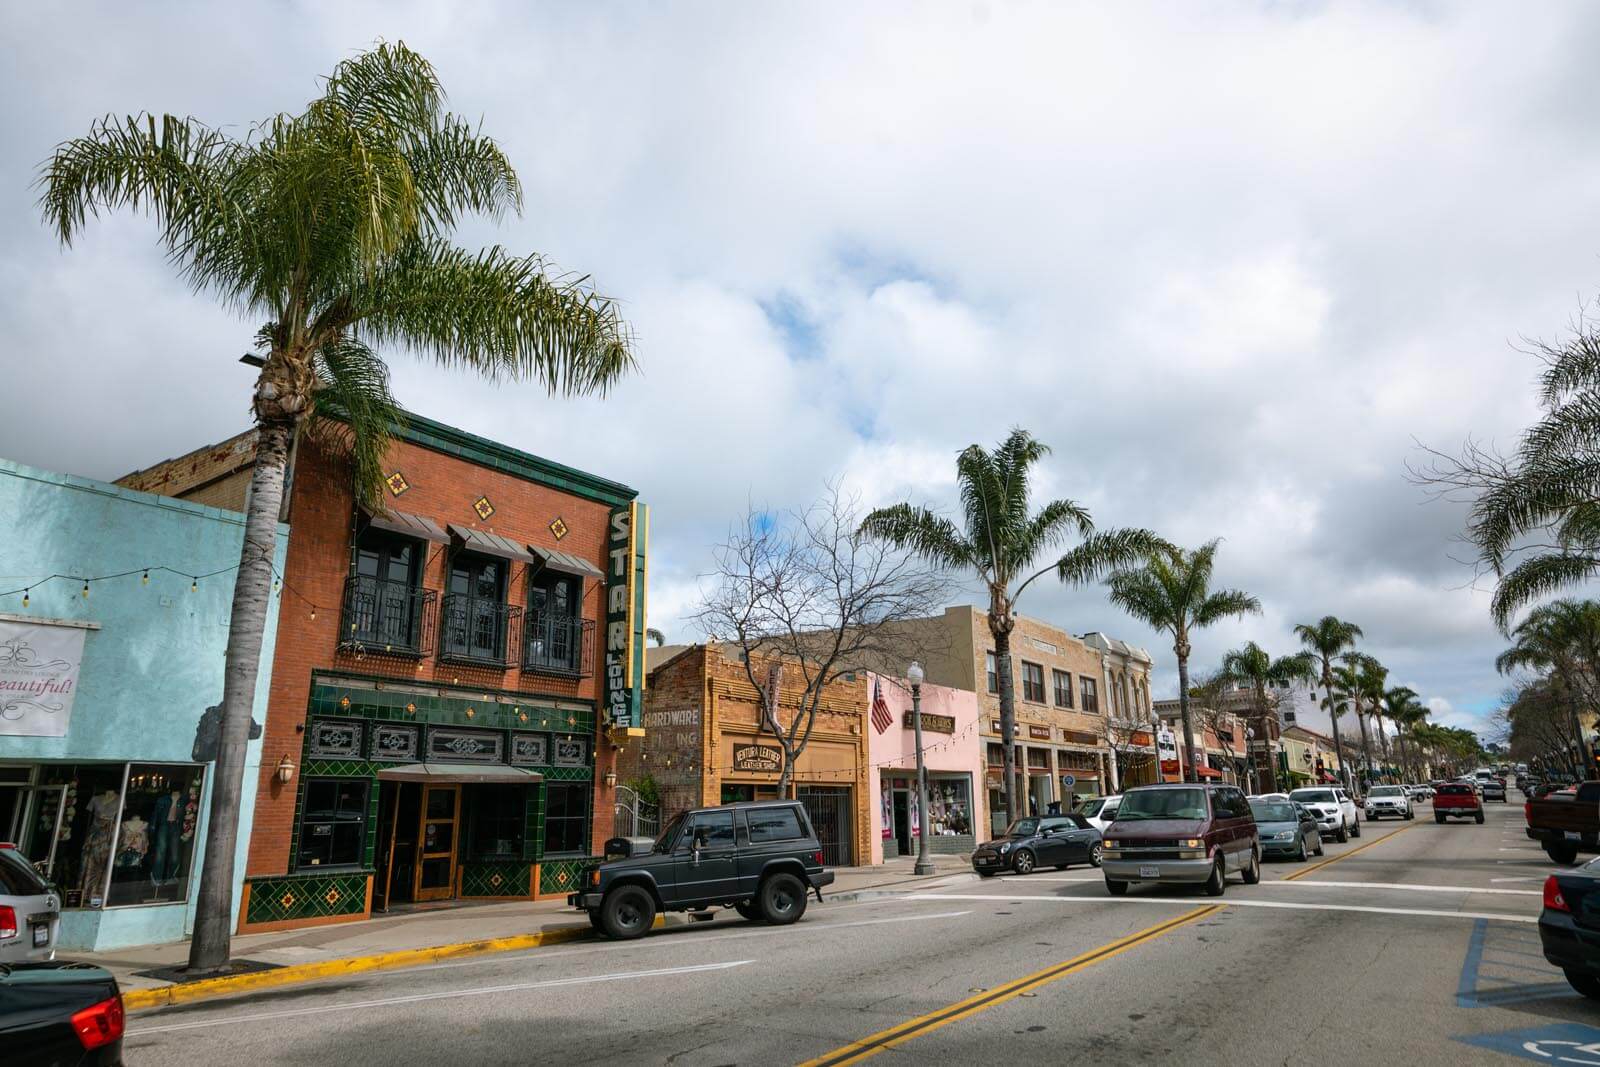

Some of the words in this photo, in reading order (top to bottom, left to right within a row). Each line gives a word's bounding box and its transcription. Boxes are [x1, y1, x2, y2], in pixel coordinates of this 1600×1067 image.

[608, 511, 630, 651] STAR
[606, 652, 631, 728] LOUNGE
[644, 710, 699, 727] HARDWARE
[736, 746, 758, 762] VENTURA
[759, 746, 781, 763] LEATHER
